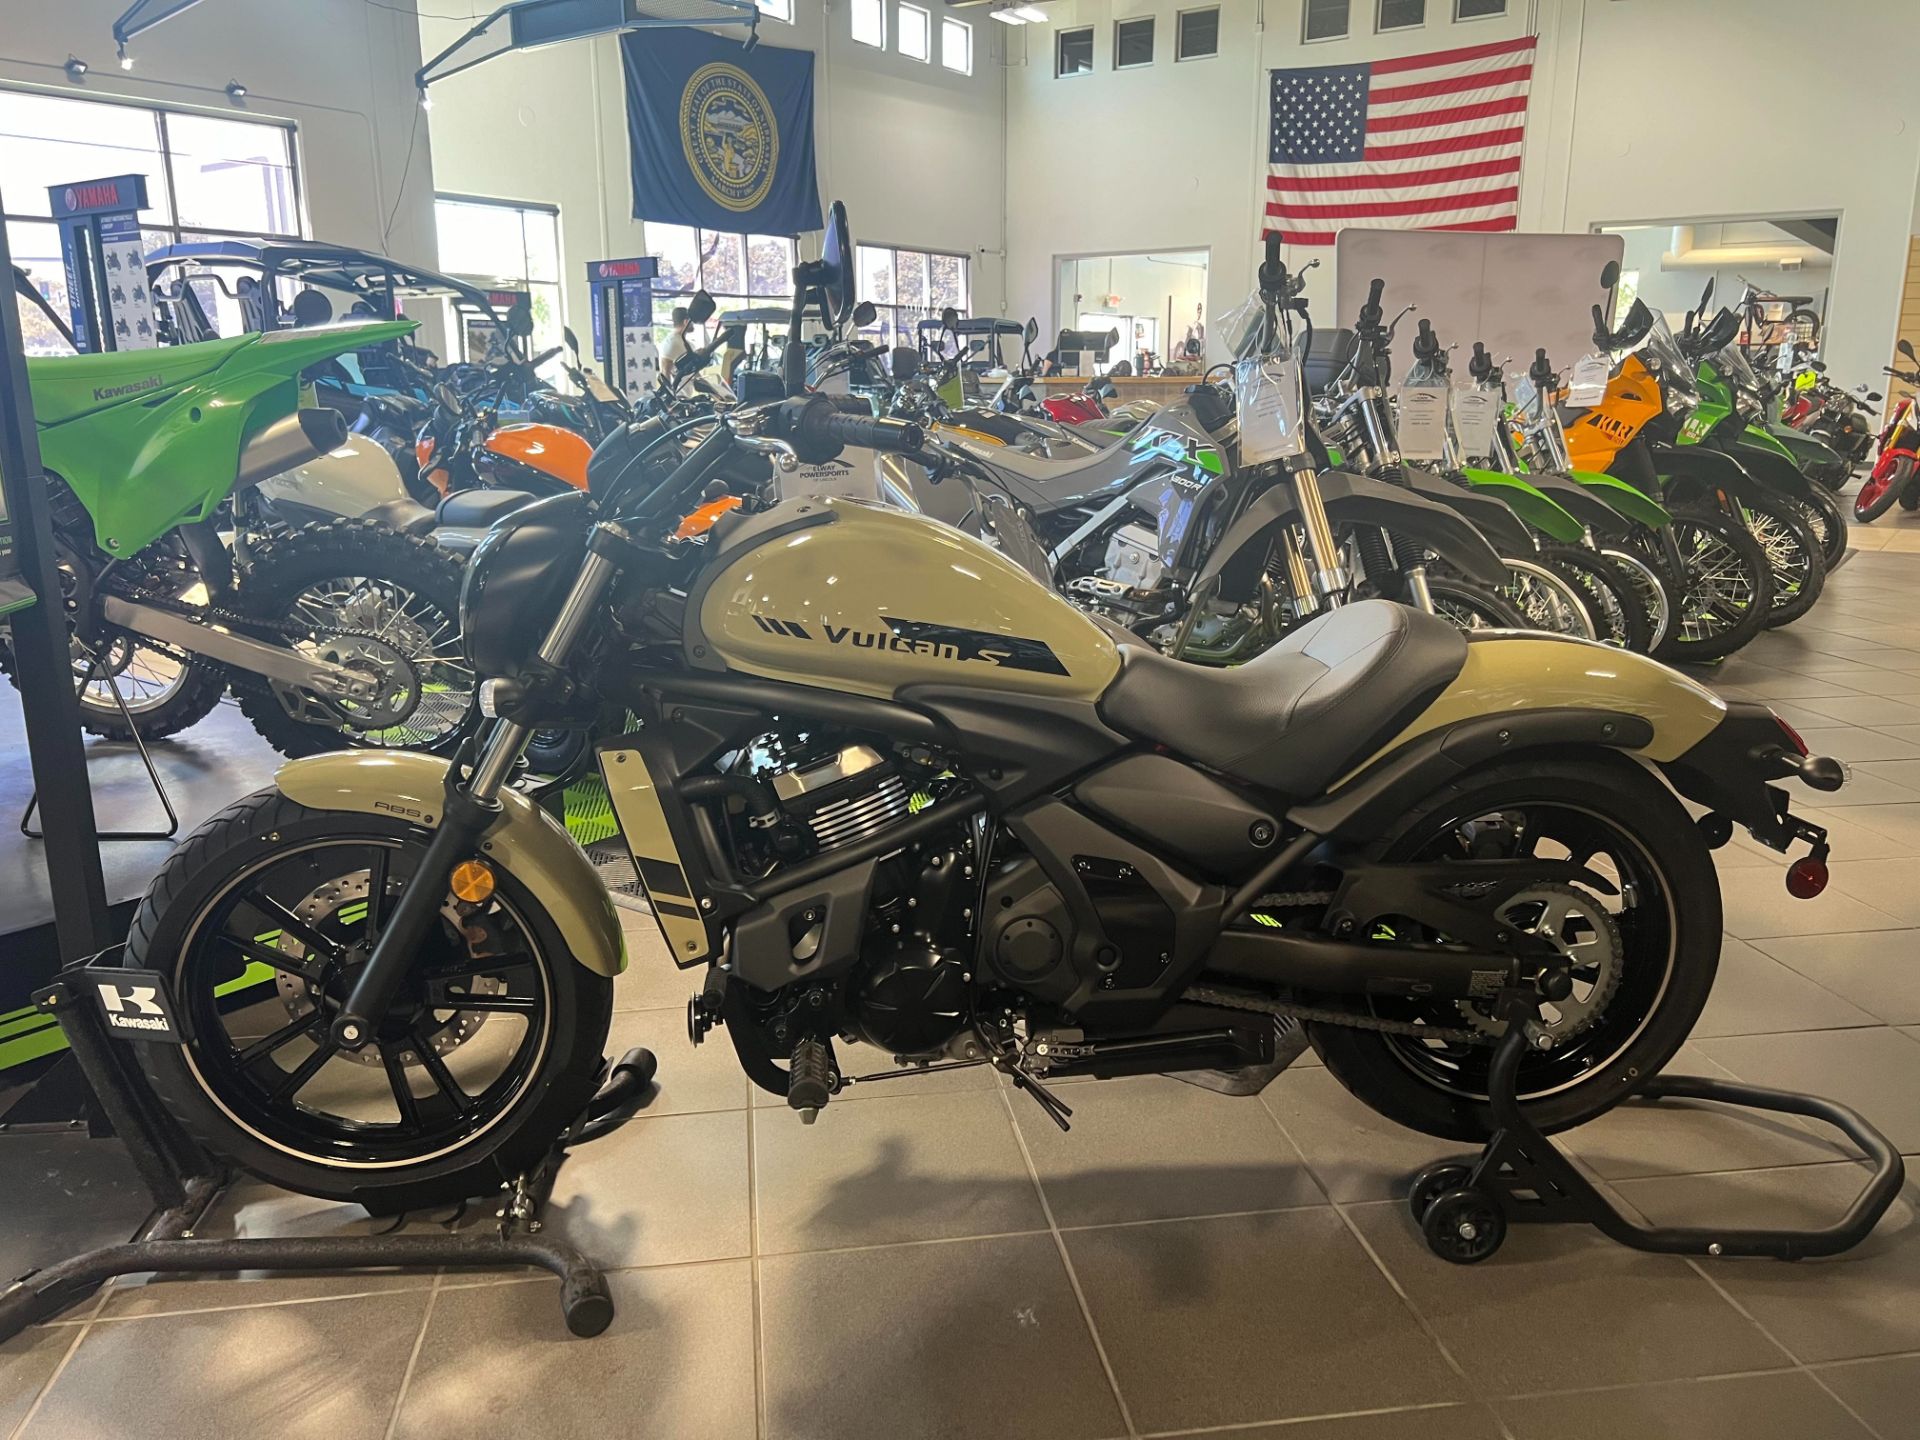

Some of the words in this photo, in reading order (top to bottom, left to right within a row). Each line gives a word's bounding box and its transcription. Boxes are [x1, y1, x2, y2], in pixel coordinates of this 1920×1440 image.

[710, 77, 726, 89] THE
[727, 78, 752, 100] STATE
[75, 184, 119, 209] YAMAHA
[607, 262, 640, 276] YAMAHA
[93, 374, 164, 401] Kawasaki
[799, 469, 849, 479] POWERSPORTS
[823, 624, 960, 661] Vulcan
[963, 648, 1012, 667] S
[374, 801, 421, 818] ABS
[108, 1013, 170, 1031] Kawasaki
